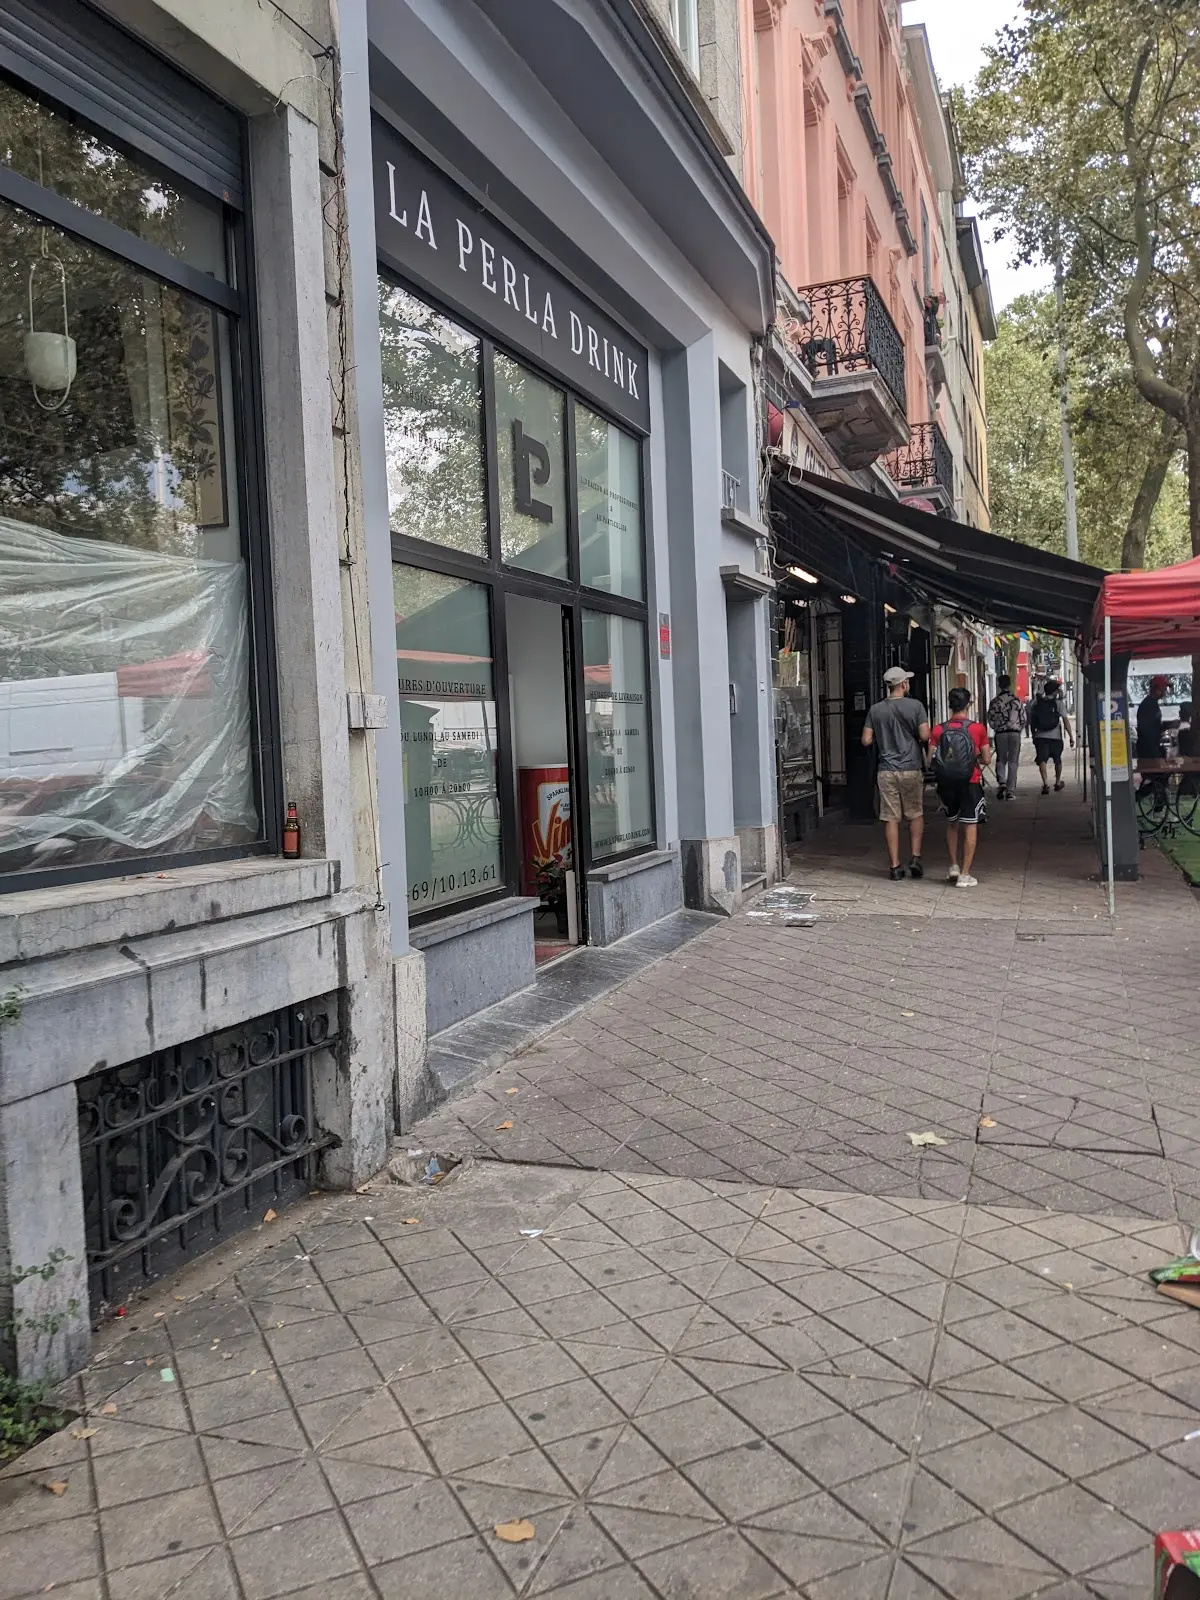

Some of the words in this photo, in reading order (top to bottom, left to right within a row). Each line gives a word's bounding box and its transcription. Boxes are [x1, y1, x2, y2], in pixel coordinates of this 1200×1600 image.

[386, 161, 437, 250] LA
[456, 219, 558, 339] PERLA
[569, 311, 639, 400] DRINK
[398, 679, 423, 691] URES
[426, 680, 486, 695] D'OUVERTURE
[413, 732, 437, 742] LUNDI
[440, 732, 450, 742] AU
[452, 731, 480, 741] SAMEDI
[437, 758, 448, 768] DE
[414, 786, 439, 798] 10H00
[407, 864, 496, 901] 69/10.13.61
